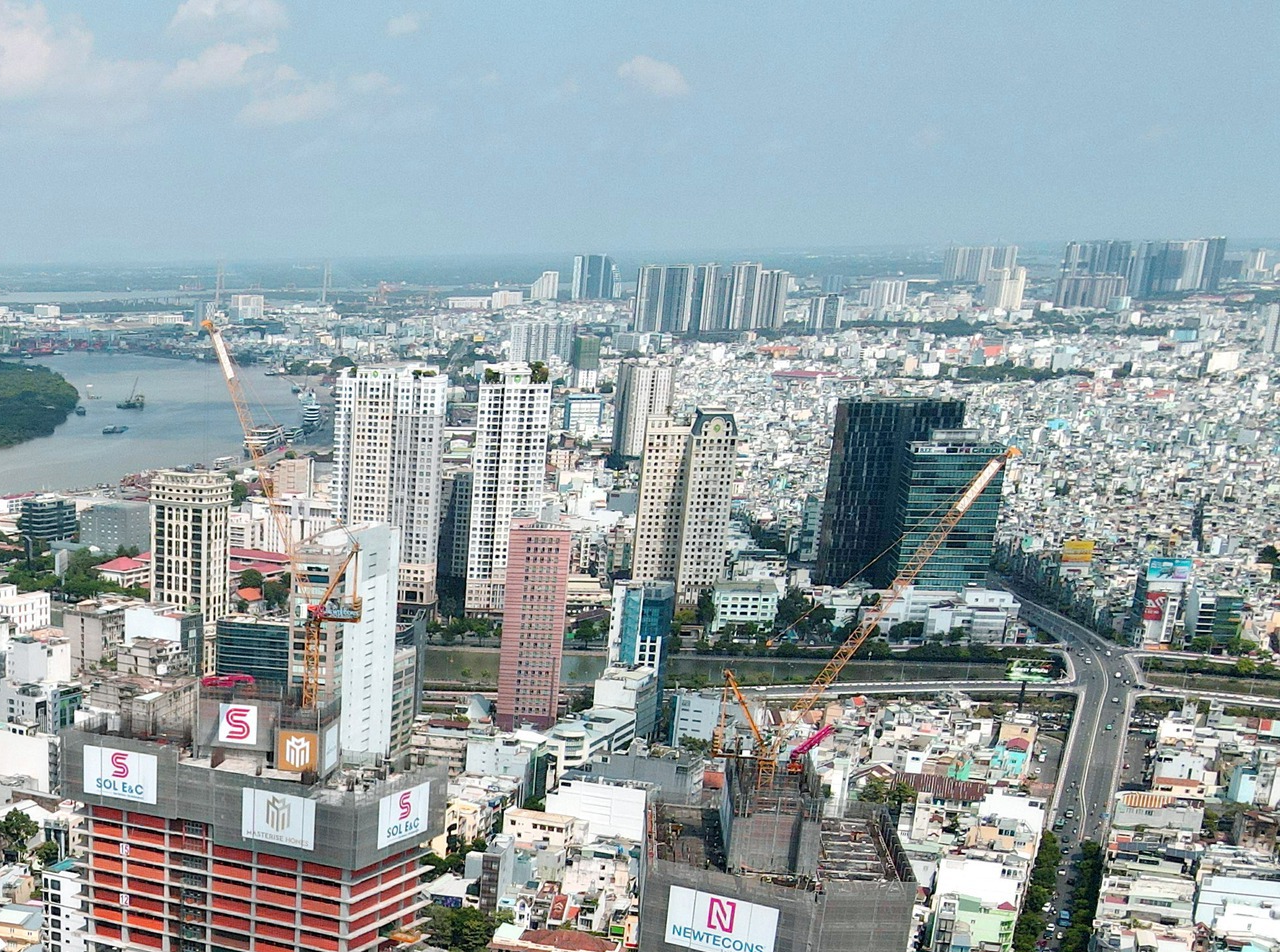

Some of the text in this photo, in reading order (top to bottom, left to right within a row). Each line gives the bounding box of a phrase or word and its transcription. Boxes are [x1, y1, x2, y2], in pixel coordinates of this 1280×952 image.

[96, 778, 118, 791] SOL
[122, 781, 144, 795] E&C
[246, 830, 284, 841] MASTERISE
[387, 823, 402, 838] SOL
[405, 817, 419, 832] E&C
